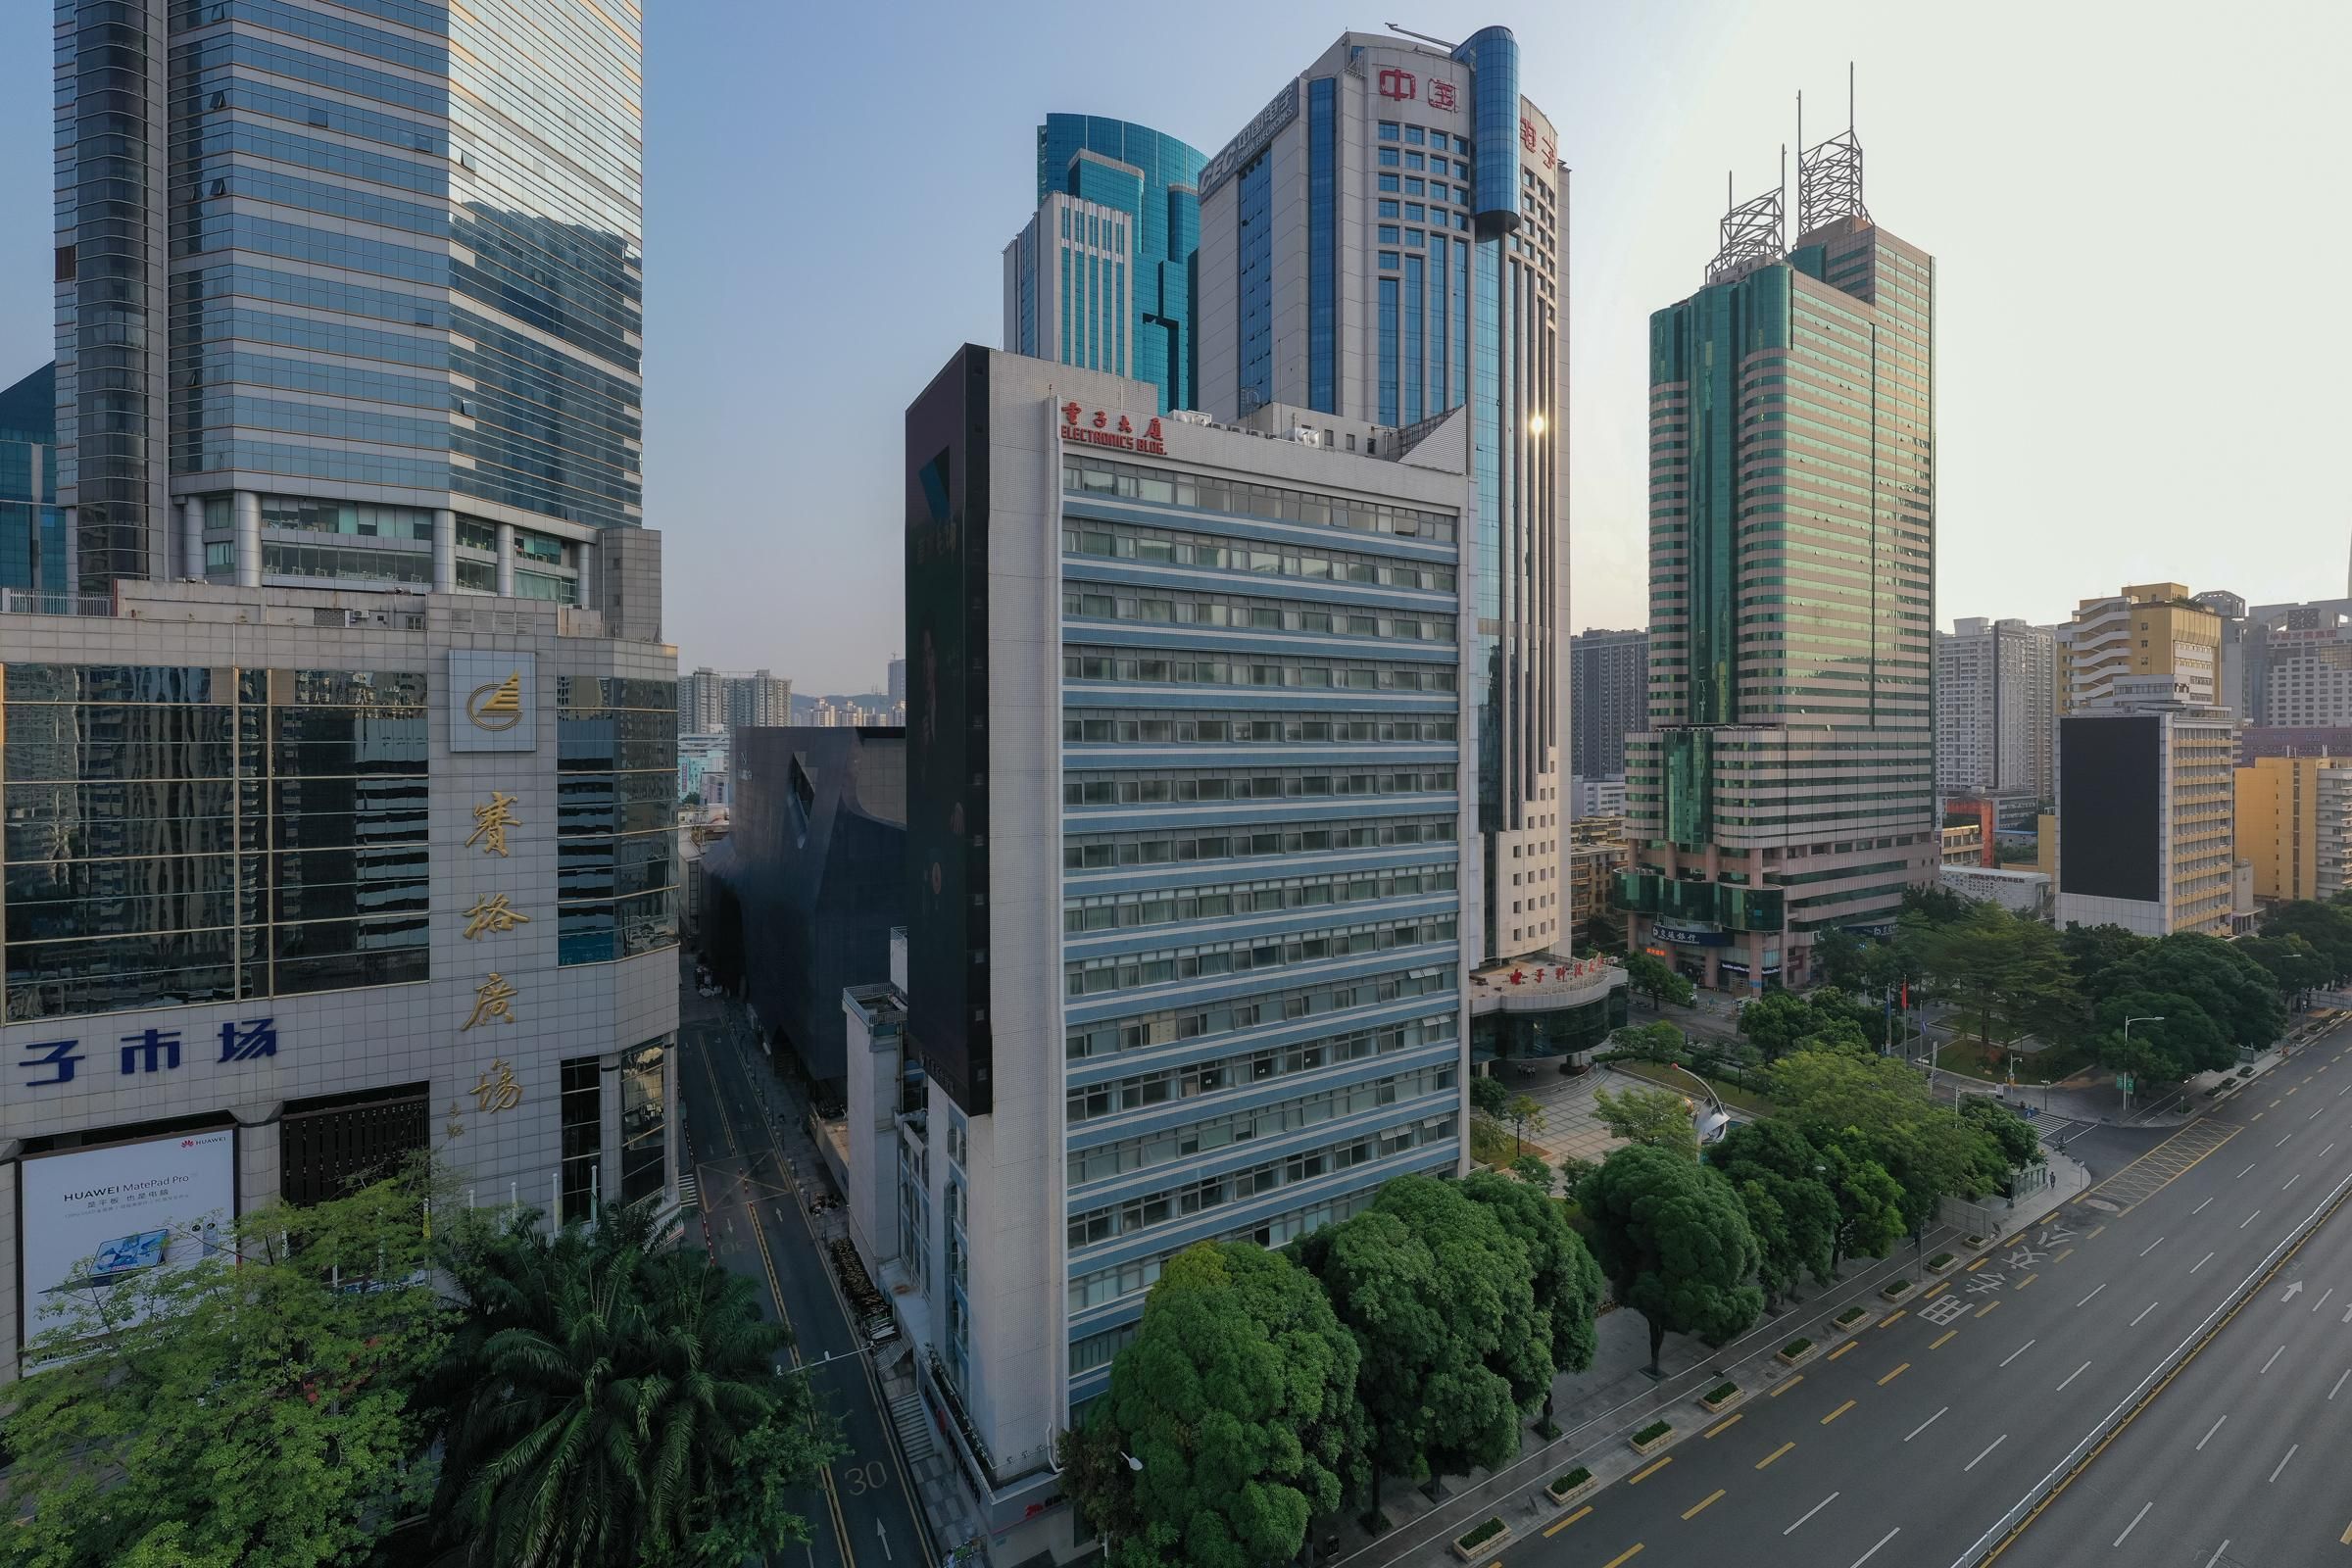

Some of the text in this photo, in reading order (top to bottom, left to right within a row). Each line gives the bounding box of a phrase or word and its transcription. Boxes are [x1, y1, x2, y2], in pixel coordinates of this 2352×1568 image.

[1379, 68, 1458, 113] 中国
[1238, 86, 1293, 150] 中国电子
[1200, 144, 1237, 195] CEC
[1060, 425, 1134, 451] ELECTRONICS
[19, 1017, 278, 1088] 子市场
[195, 1136, 226, 1147] HUAWEI
[64, 1174, 189, 1202] HUAWEI MatePad Pro
[844, 1460, 888, 1496] 30
